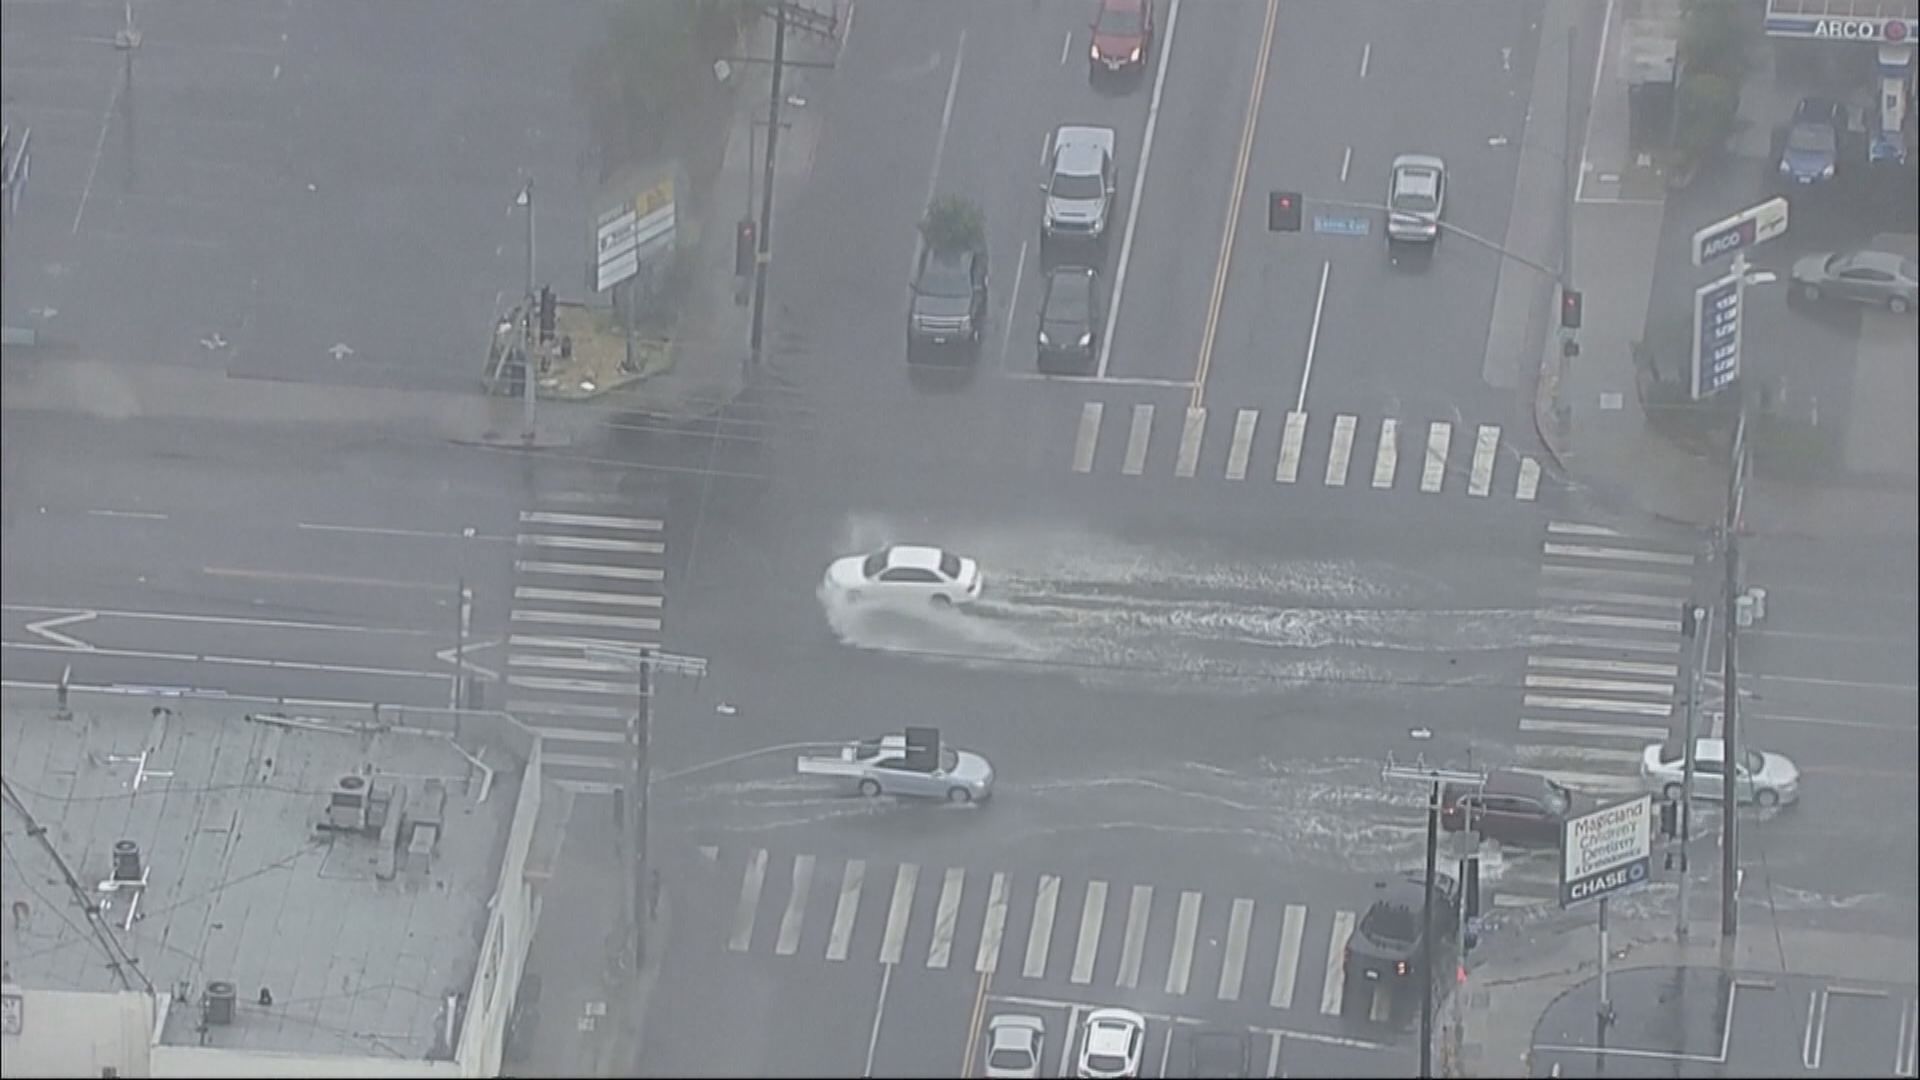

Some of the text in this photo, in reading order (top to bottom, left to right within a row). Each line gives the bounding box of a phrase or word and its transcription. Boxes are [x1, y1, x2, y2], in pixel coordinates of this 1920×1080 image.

[1815, 19, 1874, 38] ARCO
[1703, 231, 1741, 258] ARCO
[1575, 803, 1643, 837] Magicland
[1583, 838, 1635, 864] Dentistry
[1571, 868, 1626, 898] CHASE
